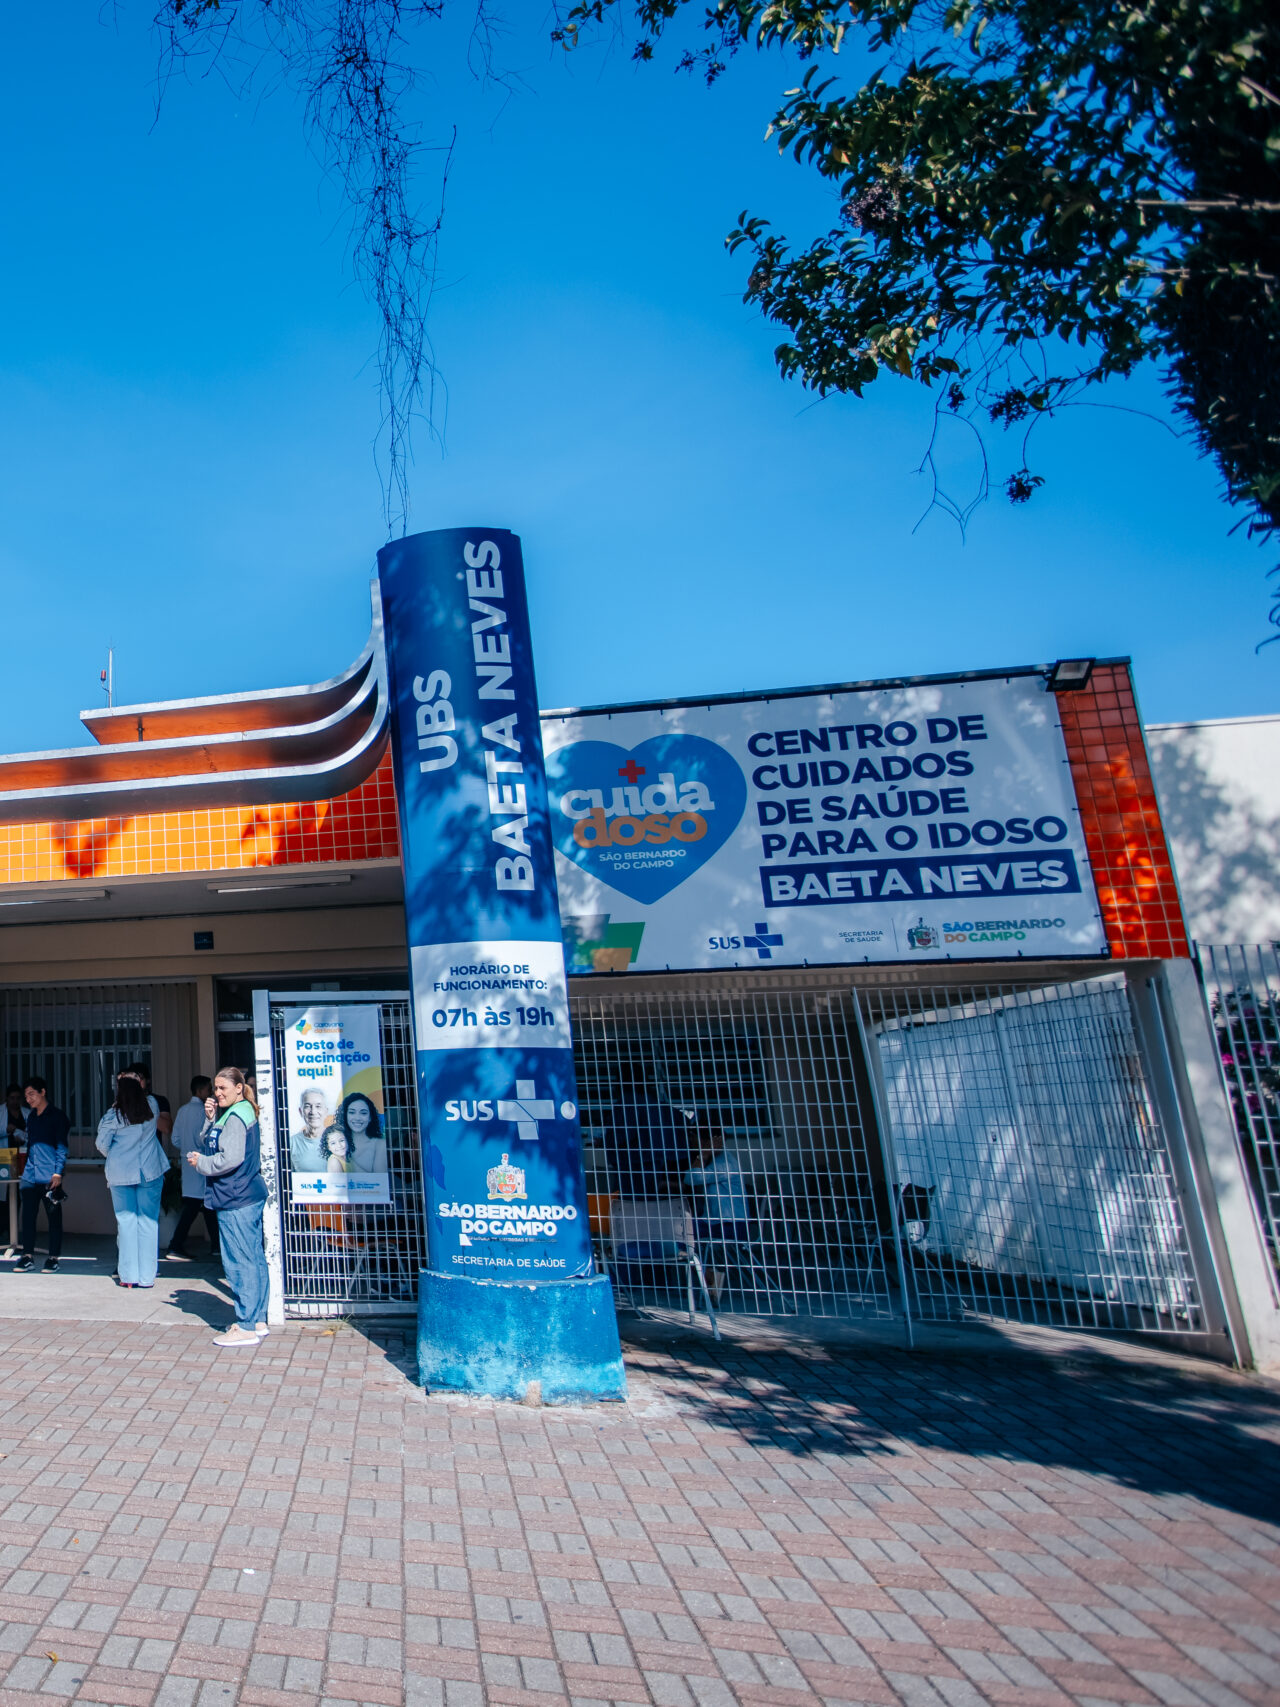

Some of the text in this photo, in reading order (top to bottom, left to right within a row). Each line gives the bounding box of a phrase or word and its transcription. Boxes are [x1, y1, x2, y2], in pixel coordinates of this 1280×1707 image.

[413, 669, 459, 773] UBS
[463, 540, 536, 891] BAETA NEVES
[747, 714, 988, 757] CENTRO DE
[752, 750, 974, 790] CUIDADOS
[560, 772, 716, 820] cuida
[757, 785, 969, 826] DE SAÚDE
[573, 807, 708, 848] doso
[761, 815, 1068, 859] PARA O IDOSO
[599, 849, 686, 862] SÃO BERNARDO
[613, 859, 674, 870] DO CAMPO
[769, 860, 1069, 902] BAETA NEVES
[942, 918, 1066, 933] SÃO BERNARDO
[708, 936, 741, 950] SUS
[944, 931, 1026, 943] DO CAMPO
[449, 962, 529, 976] HORÁRIO DE
[433, 979, 548, 993] FUNCIONAMENTO:
[432, 1006, 555, 1028] 07h às 19h
[296, 1038, 354, 1050] Posto de
[297, 1051, 371, 1066] vacinação
[297, 1064, 333, 1080] aqui!
[445, 1099, 494, 1122] SUS
[439, 1202, 577, 1220] SÃO BERNARDO
[461, 1219, 557, 1236] DO CAMPO
[451, 1255, 566, 1268] SECRETARIA DE SAÚDE
